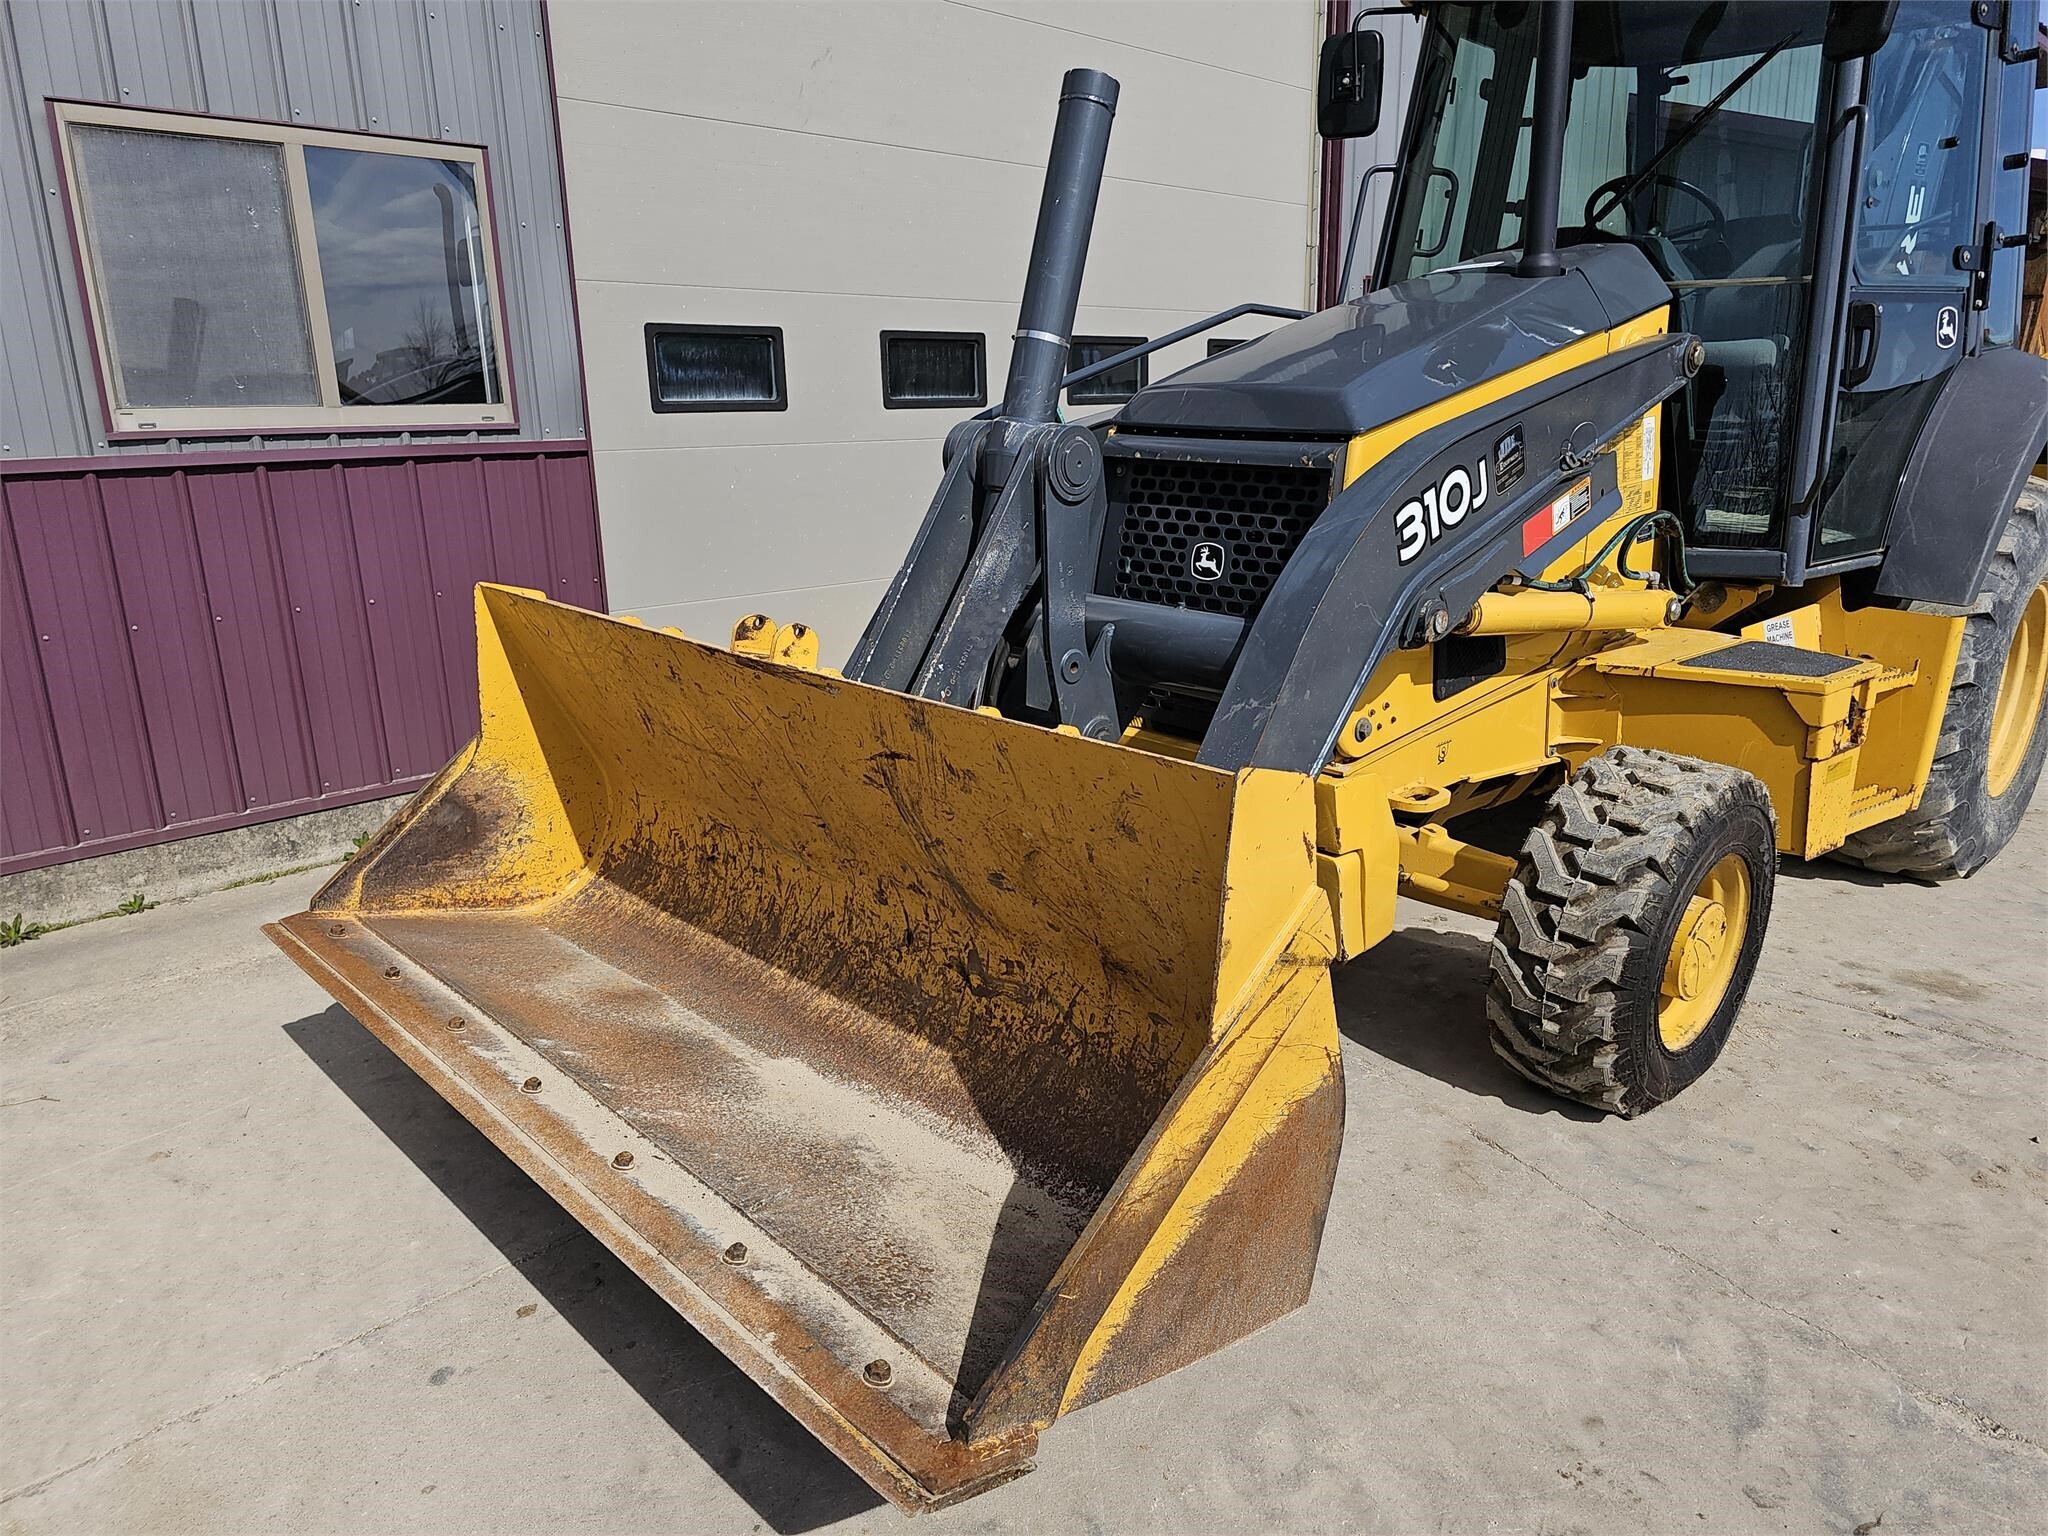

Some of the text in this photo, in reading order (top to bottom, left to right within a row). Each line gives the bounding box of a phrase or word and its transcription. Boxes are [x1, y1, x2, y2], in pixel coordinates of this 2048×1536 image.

[1394, 457, 1487, 563] 310J
[1766, 620, 1791, 633] GREASE
[1766, 631, 1793, 643] MACHINE
